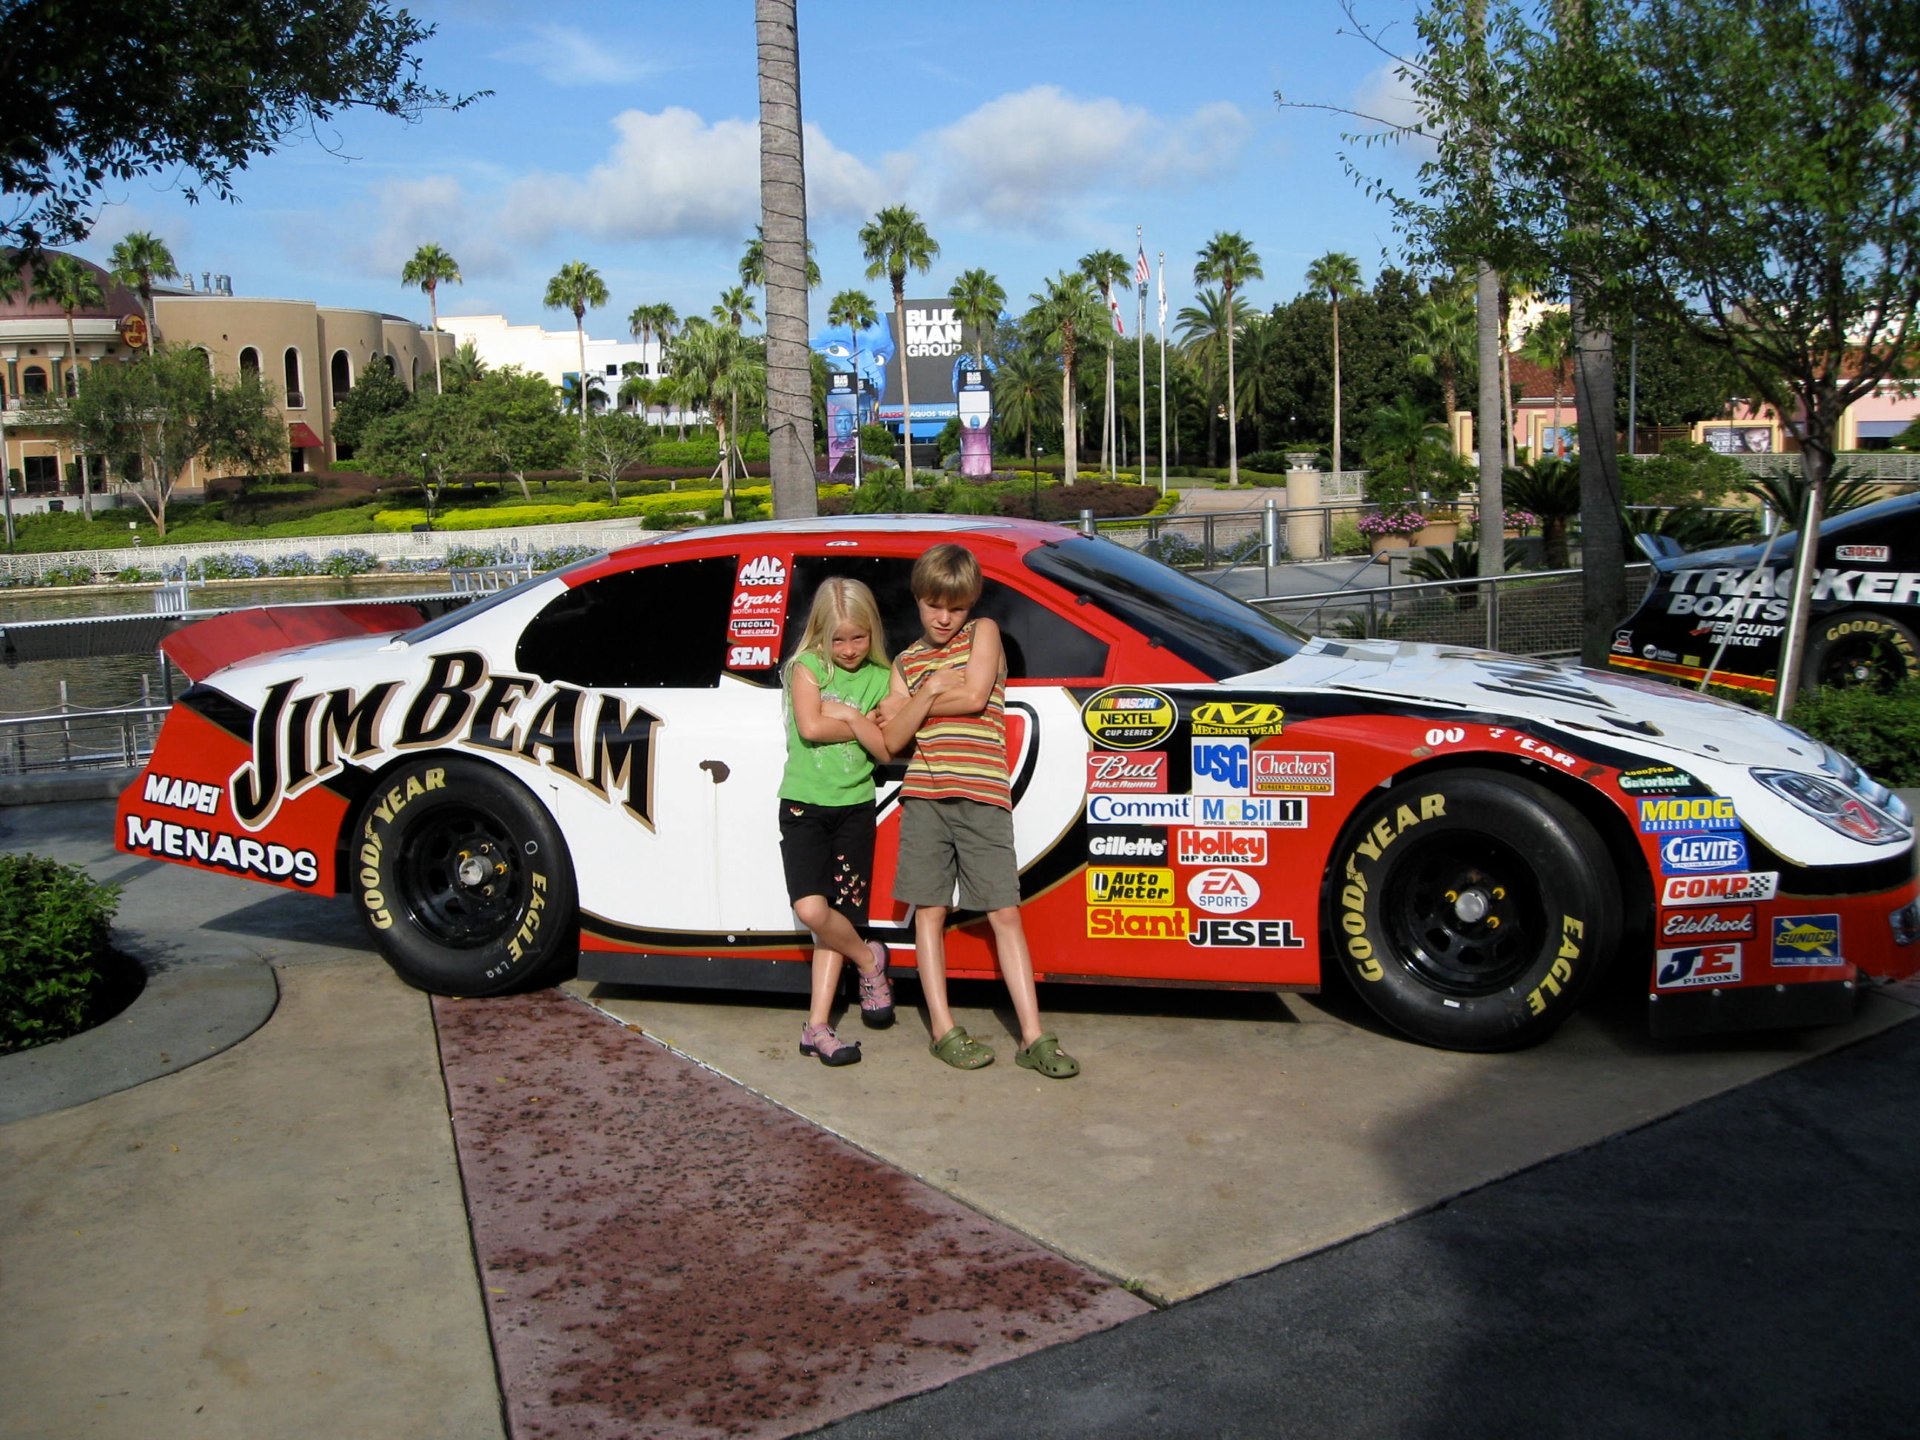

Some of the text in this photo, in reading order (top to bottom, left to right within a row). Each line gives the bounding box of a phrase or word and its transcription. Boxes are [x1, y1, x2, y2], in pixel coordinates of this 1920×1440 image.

[905, 308, 962, 326] BLUE
[906, 325, 962, 345] MAN
[906, 343, 962, 357] GROUP
[739, 555, 786, 579] MAC
[739, 577, 784, 586] TOOLS
[733, 591, 783, 608] Ozark
[1667, 595, 1788, 621] BOATS
[1709, 634, 1761, 647] ARTIC CAT
[729, 647, 770, 666] SEM
[1116, 698, 1157, 709] NASCAR
[1100, 713, 1157, 725] NEXTEL
[1192, 724, 1283, 735] MECHANIX WEAR
[233, 677, 405, 829] JIM
[394, 651, 668, 836] BEAM
[1124, 729, 1154, 737] SERIES
[1089, 755, 1166, 780] Bud
[1193, 744, 1248, 788] USG
[1257, 754, 1328, 776] Checkers
[1619, 774, 1691, 788] Gatorback
[144, 775, 220, 814] MAPEI
[1089, 796, 1189, 822] Commit
[1203, 799, 1271, 821] Mobil
[1641, 799, 1735, 821] MOOG
[1645, 818, 1735, 831] CHASSIS PARTS
[127, 816, 318, 882] MENARDS
[1089, 836, 1164, 857] Gillette
[1180, 831, 1265, 863] Holley
[1666, 837, 1738, 863] CLEVITE
[1181, 855, 1249, 863] HP CARBS
[1112, 872, 1159, 886] Auto
[1201, 872, 1247, 895] EA
[1668, 877, 1748, 899] COMP
[1107, 886, 1169, 901] Meter
[1199, 895, 1249, 908] SPORTS
[1723, 891, 1763, 900] CAMS
[508, 871, 548, 962] EAGLE
[1090, 909, 1186, 938] Stant
[1662, 914, 1752, 936] Edelbrock
[1189, 920, 1303, 947] JESEL
[1778, 932, 1832, 943] SUNOCO
[1526, 914, 1584, 1016] EAGLE
[1658, 947, 1736, 985] JE
[1683, 974, 1740, 985] PISTONS
